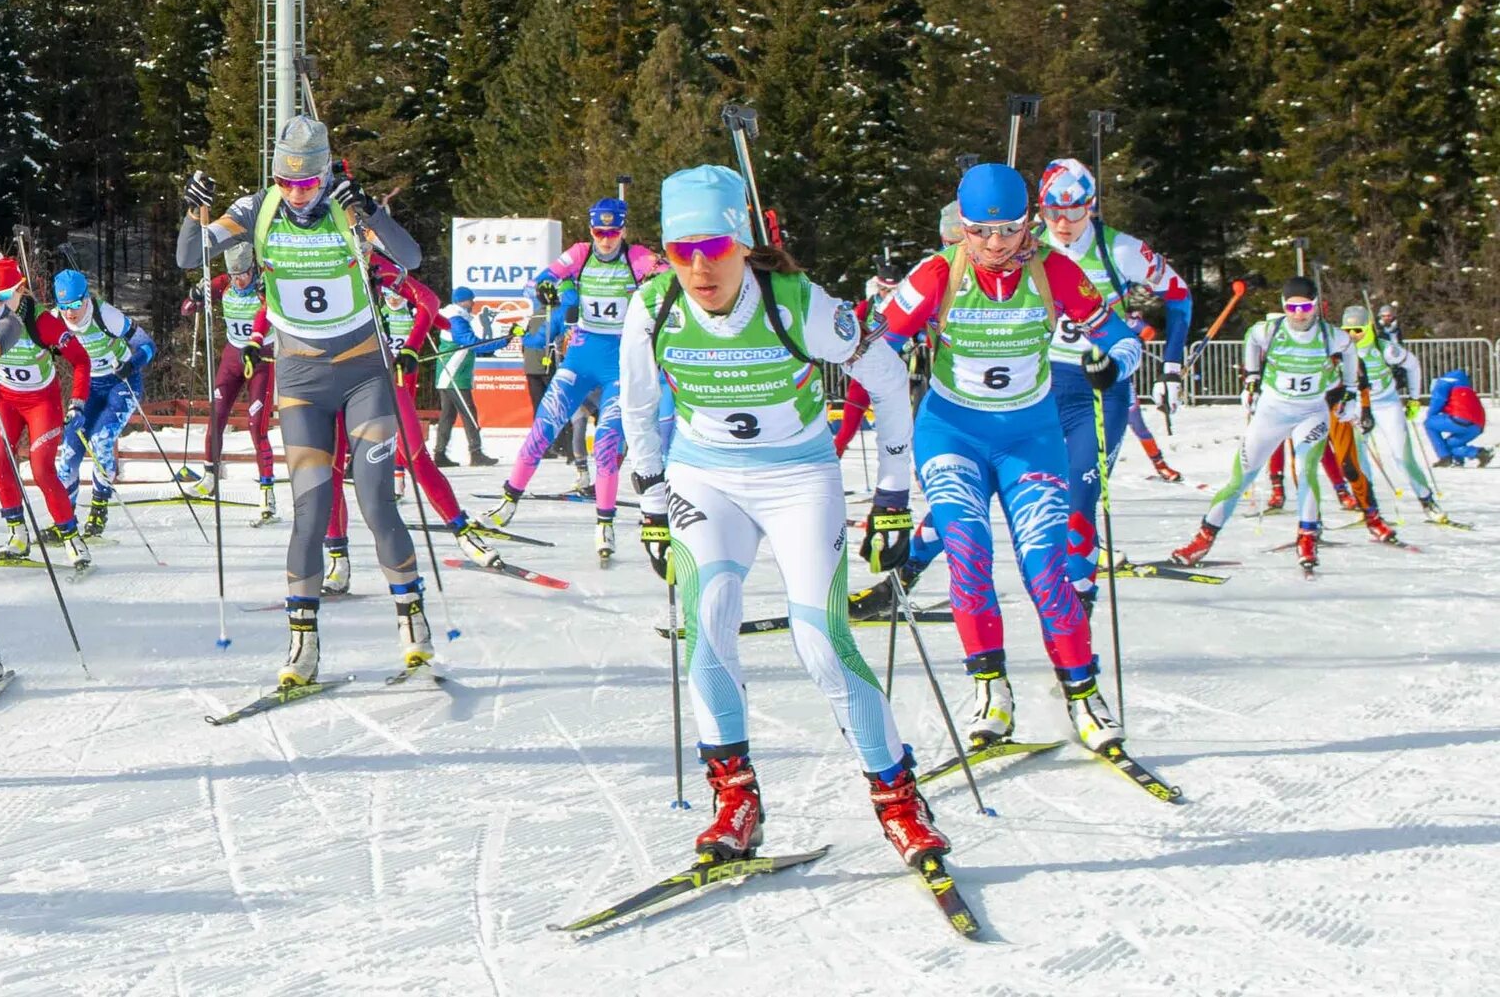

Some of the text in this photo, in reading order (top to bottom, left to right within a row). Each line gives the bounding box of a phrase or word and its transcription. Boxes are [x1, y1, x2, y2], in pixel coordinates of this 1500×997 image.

[466, 266, 537, 283] СТАРТ
[303, 286, 329, 314] 8
[589, 301, 618, 319] 14
[231, 322, 253, 337] 16
[1061, 319, 1083, 344] 9
[955, 336, 1041, 349] ХАНТЫ-МАНСИЙСК
[1, 367, 32, 382] 10
[982, 366, 1012, 390] 6
[681, 378, 789, 393] ХАНТЫ-МАНСИЙСК
[1287, 376, 1313, 393] 15
[724, 412, 761, 440] 3
